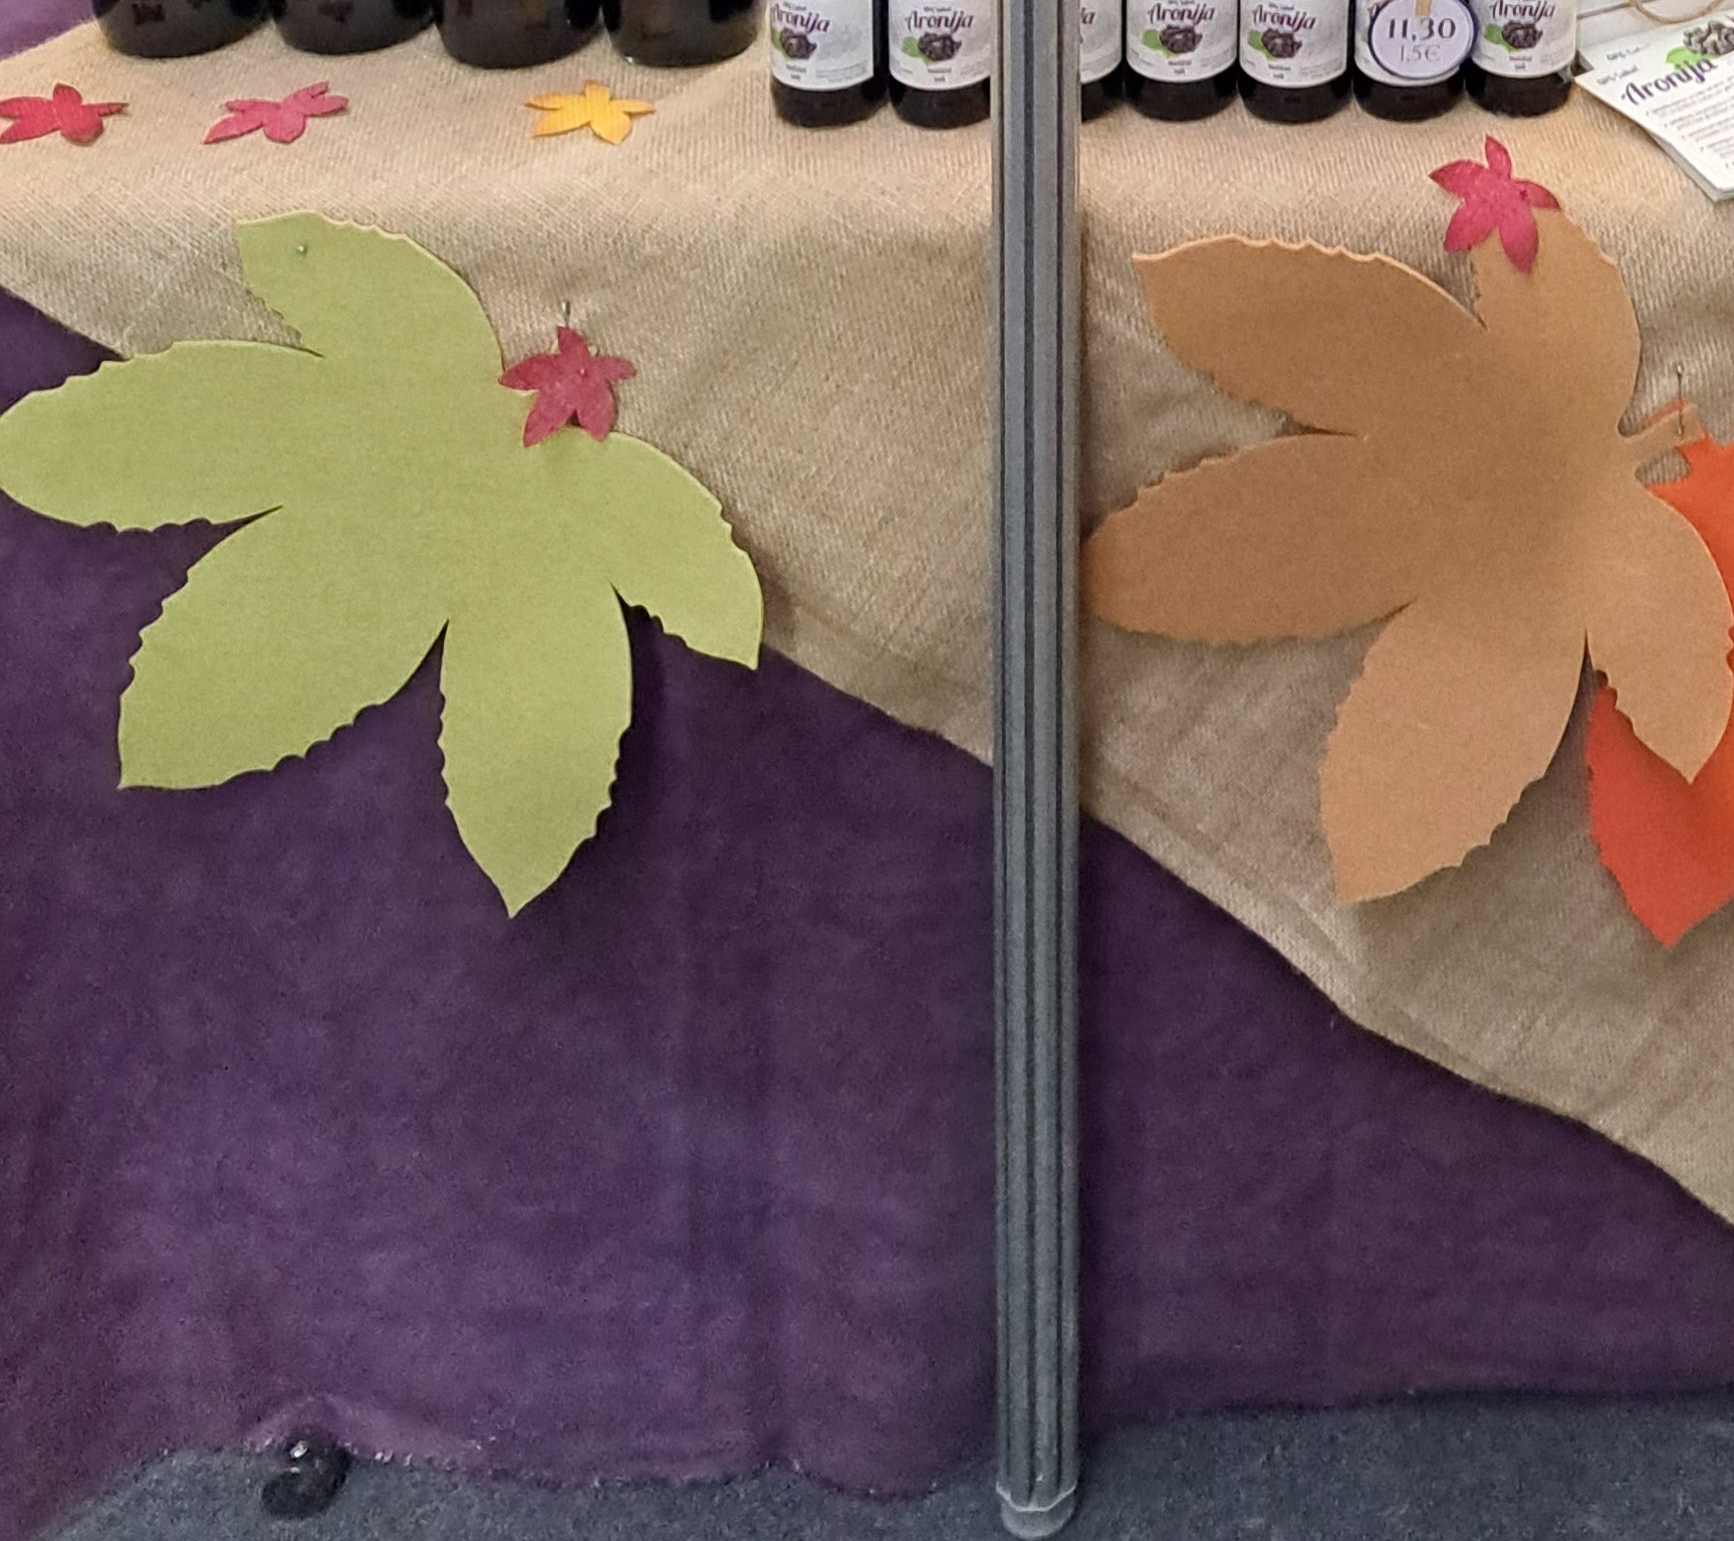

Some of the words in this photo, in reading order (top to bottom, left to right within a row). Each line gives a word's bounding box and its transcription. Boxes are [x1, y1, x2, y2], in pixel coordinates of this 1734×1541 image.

[772, 3, 831, 34] Aronija
[905, 9, 975, 33] Aronija
[1147, 2, 1216, 25] Aronija
[1252, 4, 1316, 31] Aronija
[1388, 17, 1457, 41] 11,30
[1620, 54, 1718, 105] Aronija
